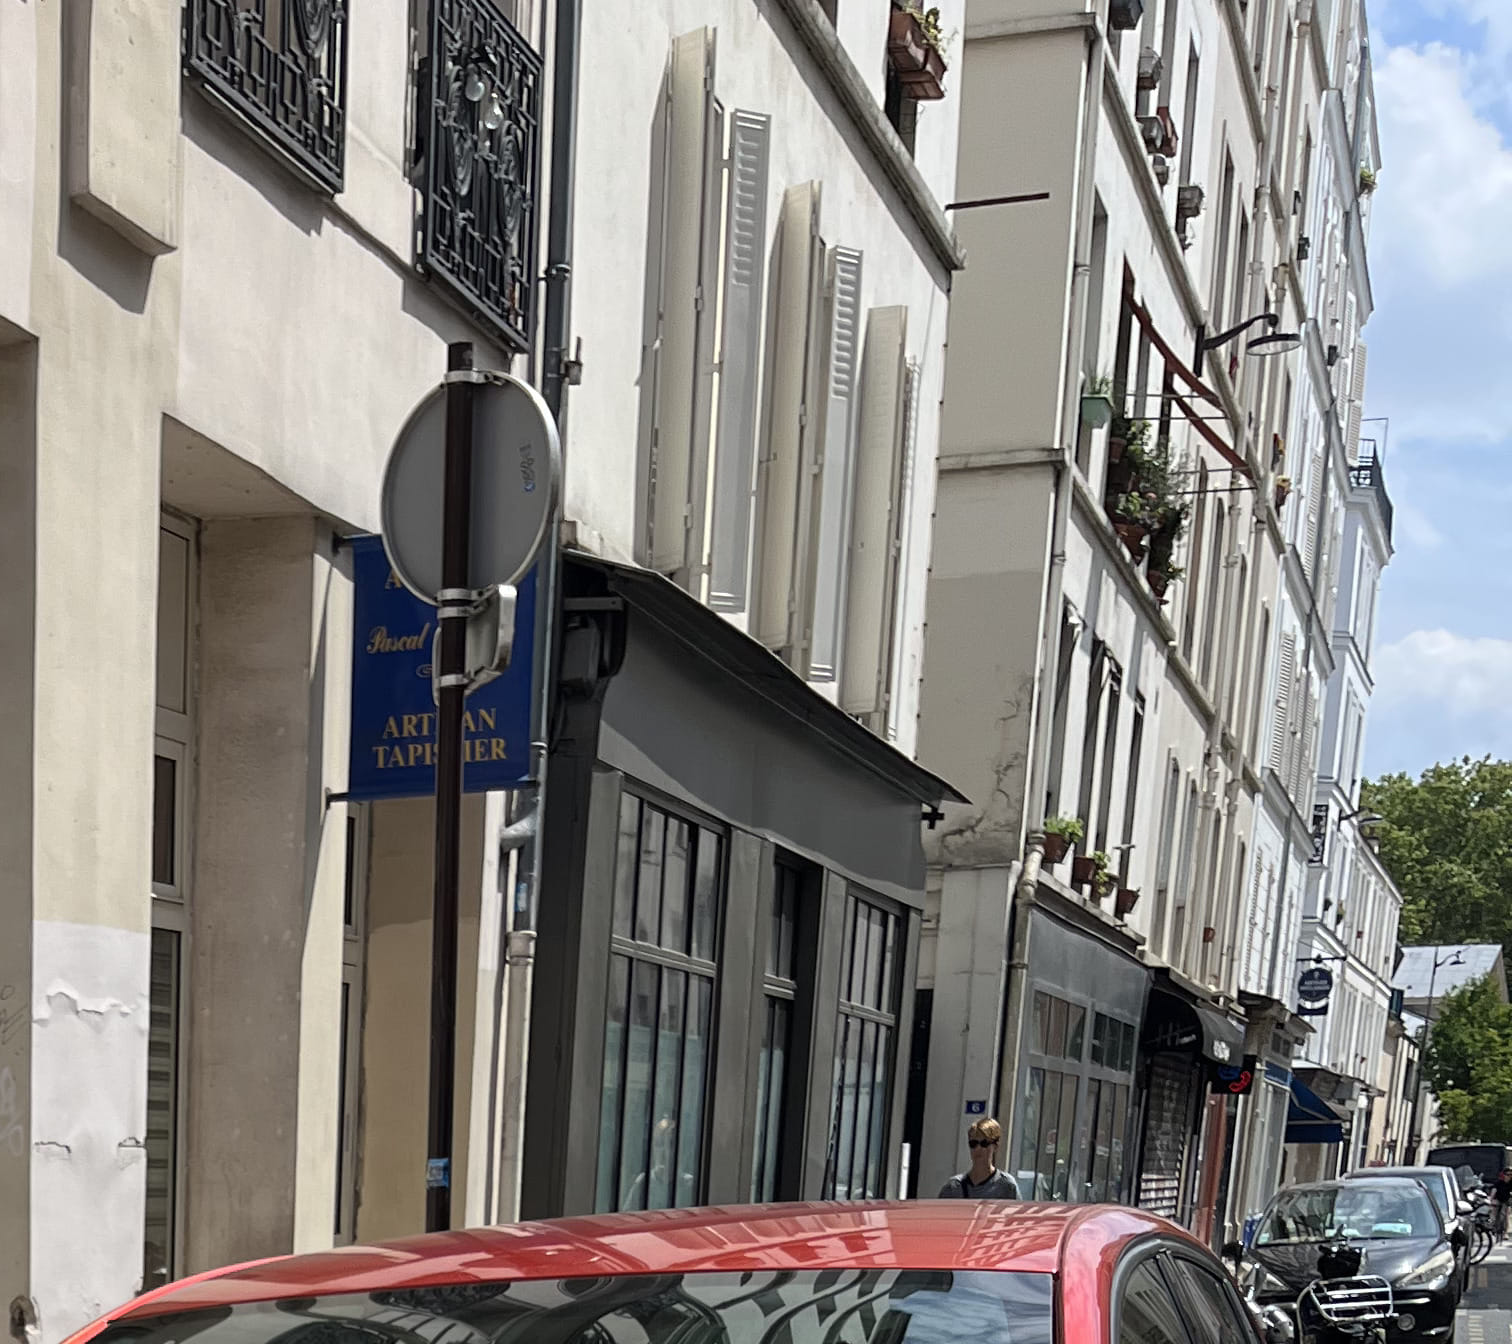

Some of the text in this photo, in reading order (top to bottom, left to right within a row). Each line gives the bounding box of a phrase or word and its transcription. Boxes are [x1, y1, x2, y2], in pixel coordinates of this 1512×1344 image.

[367, 622, 431, 654] Pascal
[382, 708, 497, 739] ARTAN
[372, 738, 507, 769] TAPIIER
